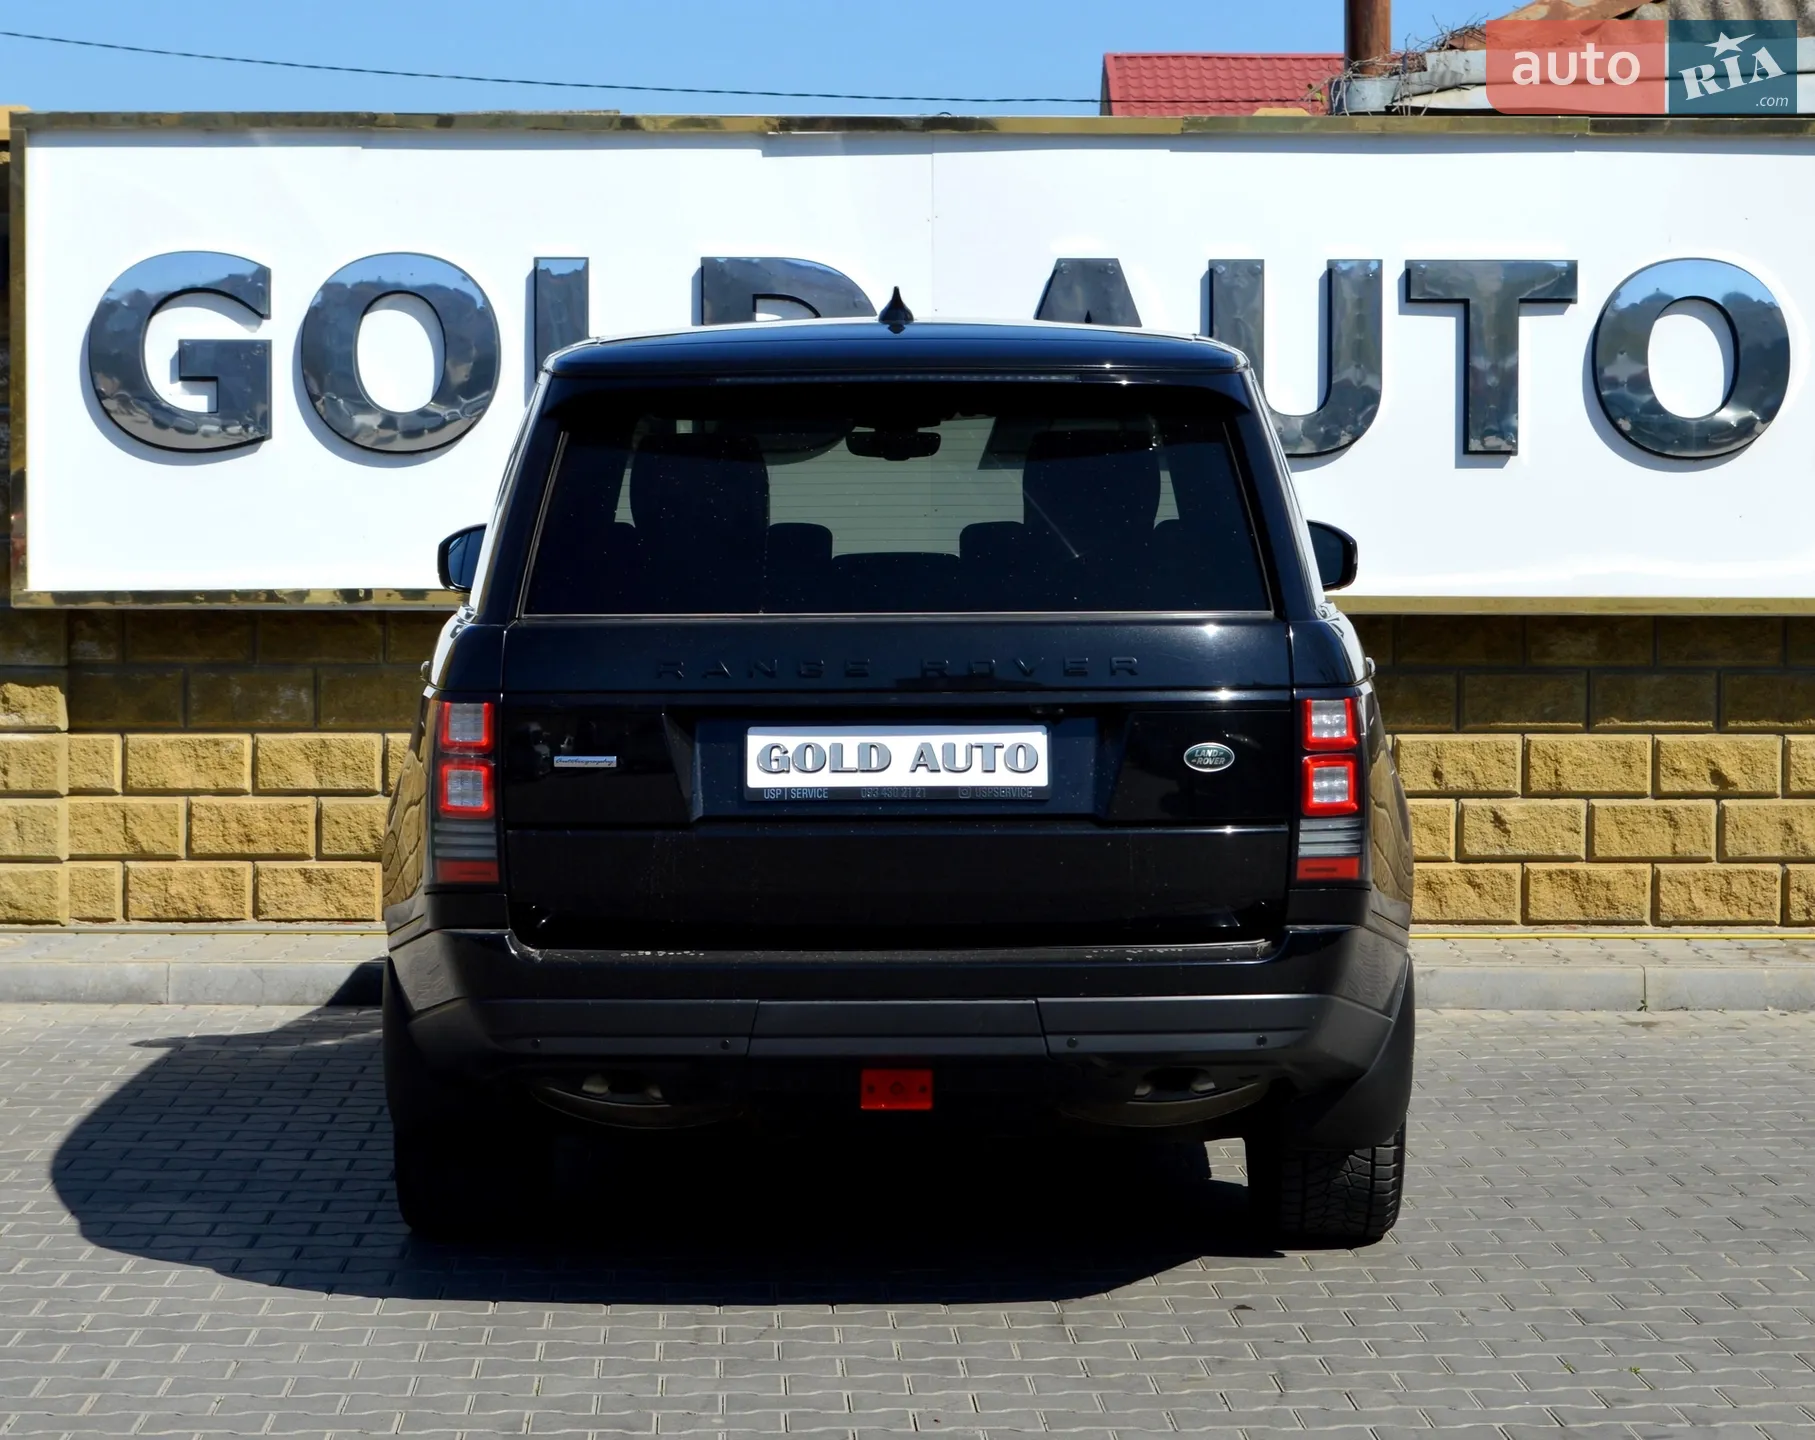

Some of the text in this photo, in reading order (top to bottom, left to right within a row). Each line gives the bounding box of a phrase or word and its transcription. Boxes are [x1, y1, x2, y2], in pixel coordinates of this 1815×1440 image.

[655, 656, 1139, 680] RANGE ROVER
[756, 742, 1040, 774] GOLD AUTO
[1197, 757, 1225, 765] ROVER
[763, 787, 829, 799] USP SERVICE
